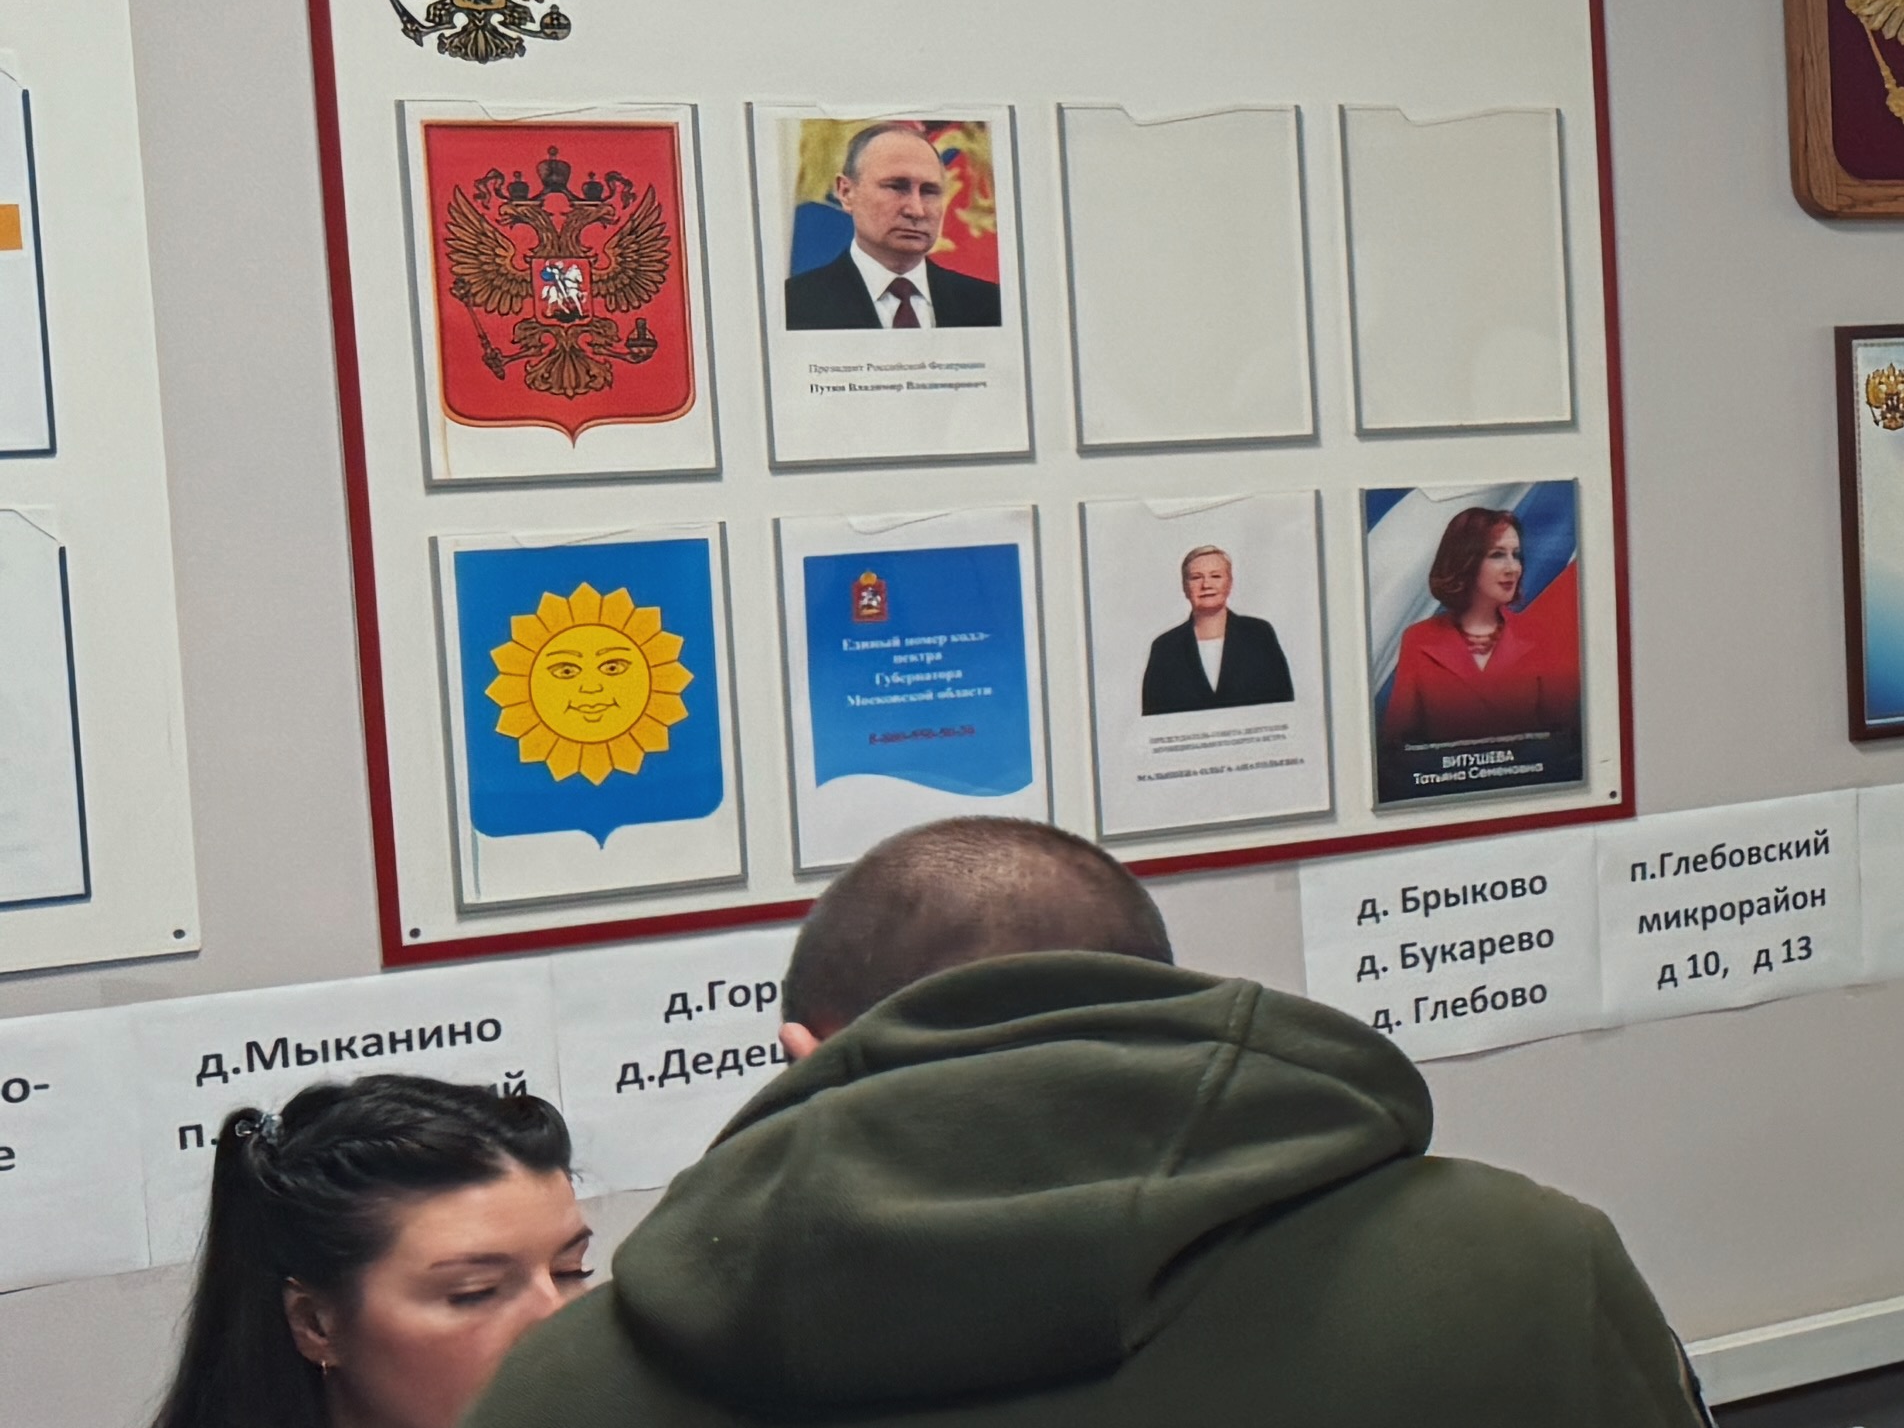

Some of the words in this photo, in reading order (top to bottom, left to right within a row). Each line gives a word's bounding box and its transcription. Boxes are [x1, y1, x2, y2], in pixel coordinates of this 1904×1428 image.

[1412, 770, 1467, 785] Татьяна
[1442, 750, 1515, 768] ВИТУШЕВА
[1630, 828, 1830, 882] п.Глебовский
[1357, 898, 1389, 926] д.
[1401, 875, 1548, 918] Брыково
[1638, 885, 1827, 935] микрорайон
[1356, 955, 1388, 983] д.
[1400, 928, 1555, 973] Букарево
[1657, 963, 1678, 990] д
[1687, 950, 1729, 979] 10,
[1753, 948, 1773, 974] д
[1781, 935, 1813, 964] 13
[664, 980, 778, 1023] д.Гор
[1373, 1009, 1402, 1034] д.
[1414, 983, 1548, 1024] Глебово
[195, 1017, 502, 1087] д.Мыканино
